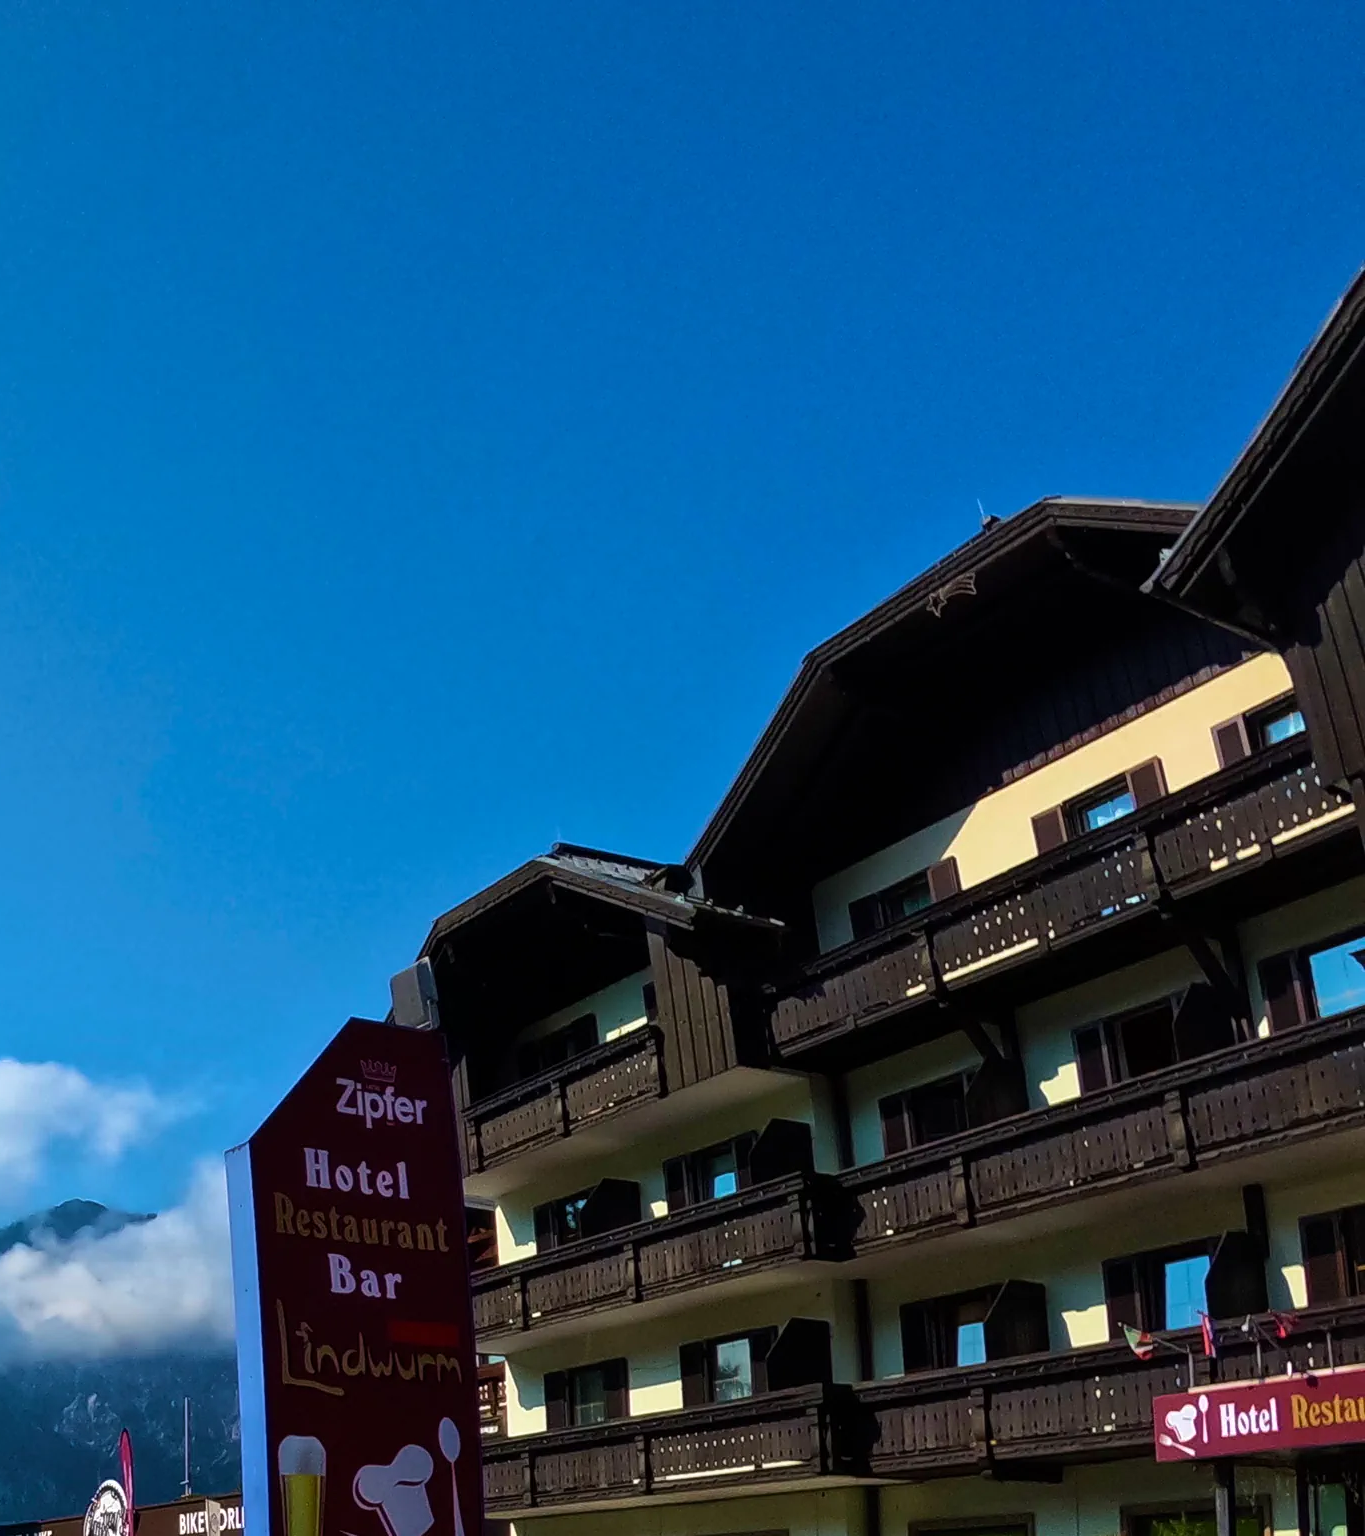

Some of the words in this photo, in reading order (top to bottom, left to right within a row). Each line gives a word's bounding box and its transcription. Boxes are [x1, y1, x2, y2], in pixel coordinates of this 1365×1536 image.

[335, 1077, 428, 1129] Zipfer
[303, 1147, 410, 1200] Hotel
[273, 1191, 450, 1252] Restaurant
[327, 1253, 403, 1300] Bar
[276, 1298, 463, 1397] Lindwurm
[1219, 1397, 1279, 1438] Hotel
[178, 1506, 246, 1536] BIKEORL
